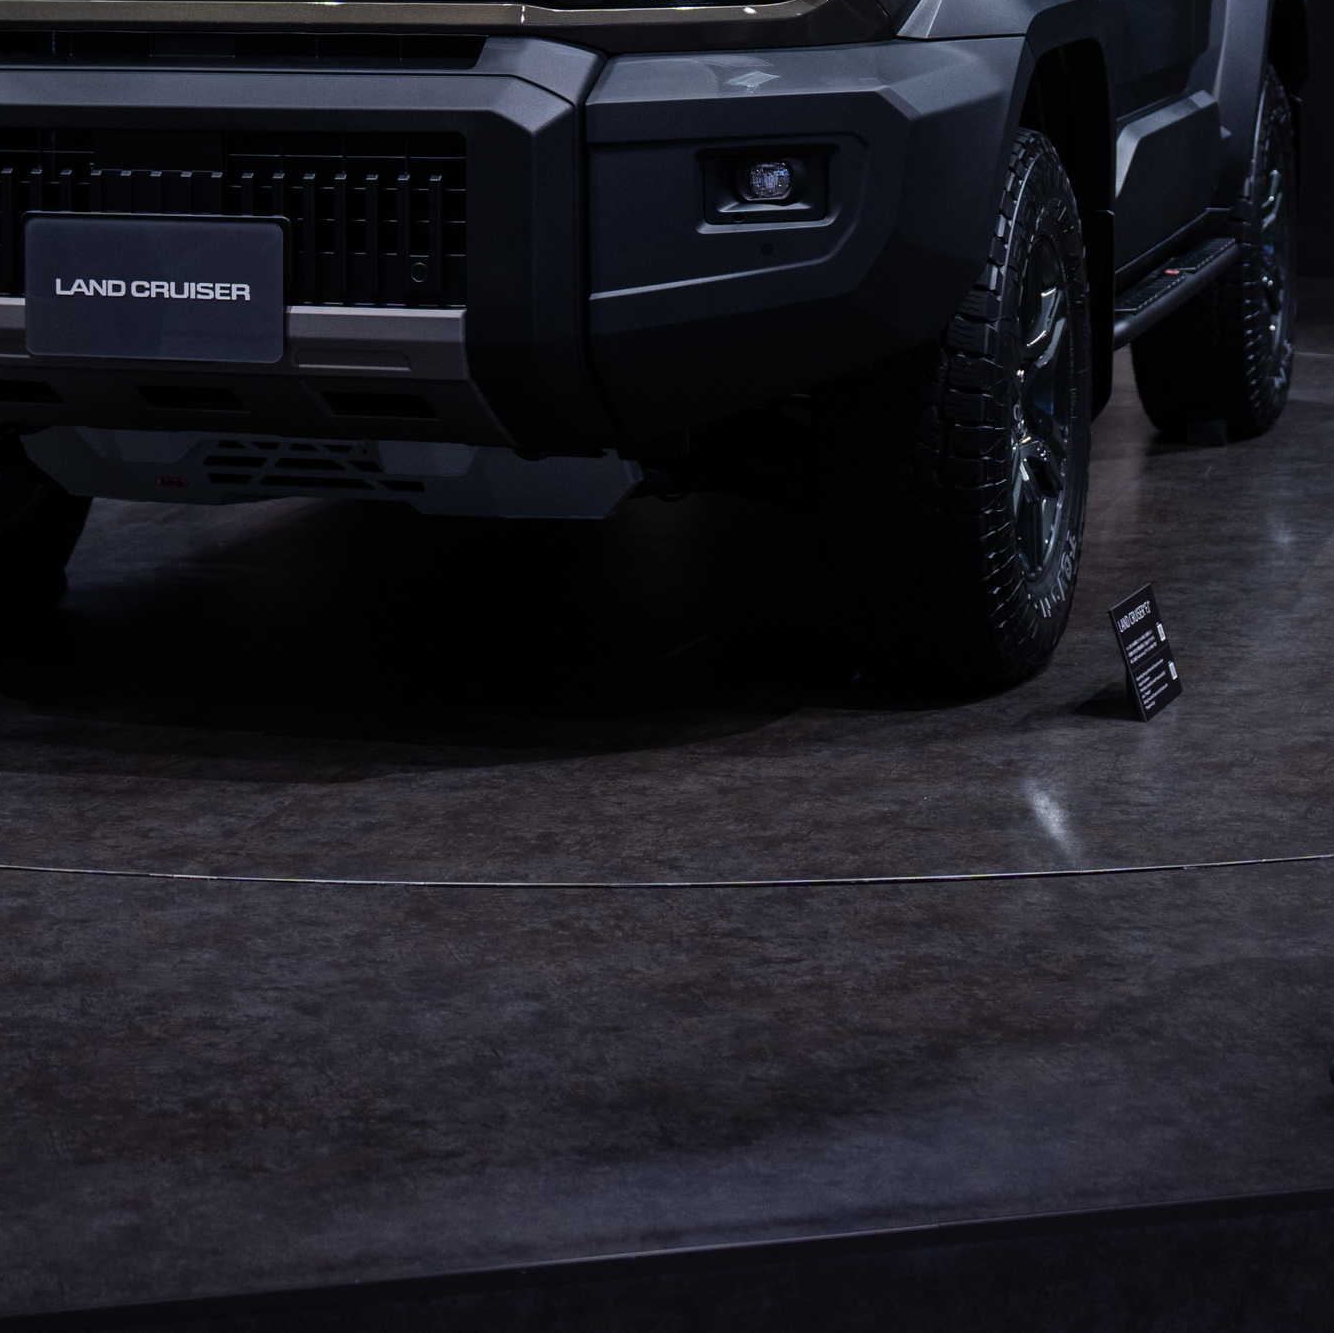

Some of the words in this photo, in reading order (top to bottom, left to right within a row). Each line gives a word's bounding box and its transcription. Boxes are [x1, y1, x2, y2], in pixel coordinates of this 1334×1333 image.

[55, 278, 127, 298] LAND
[130, 280, 252, 301] CRUISER
[1117, 613, 1131, 633] LAND
